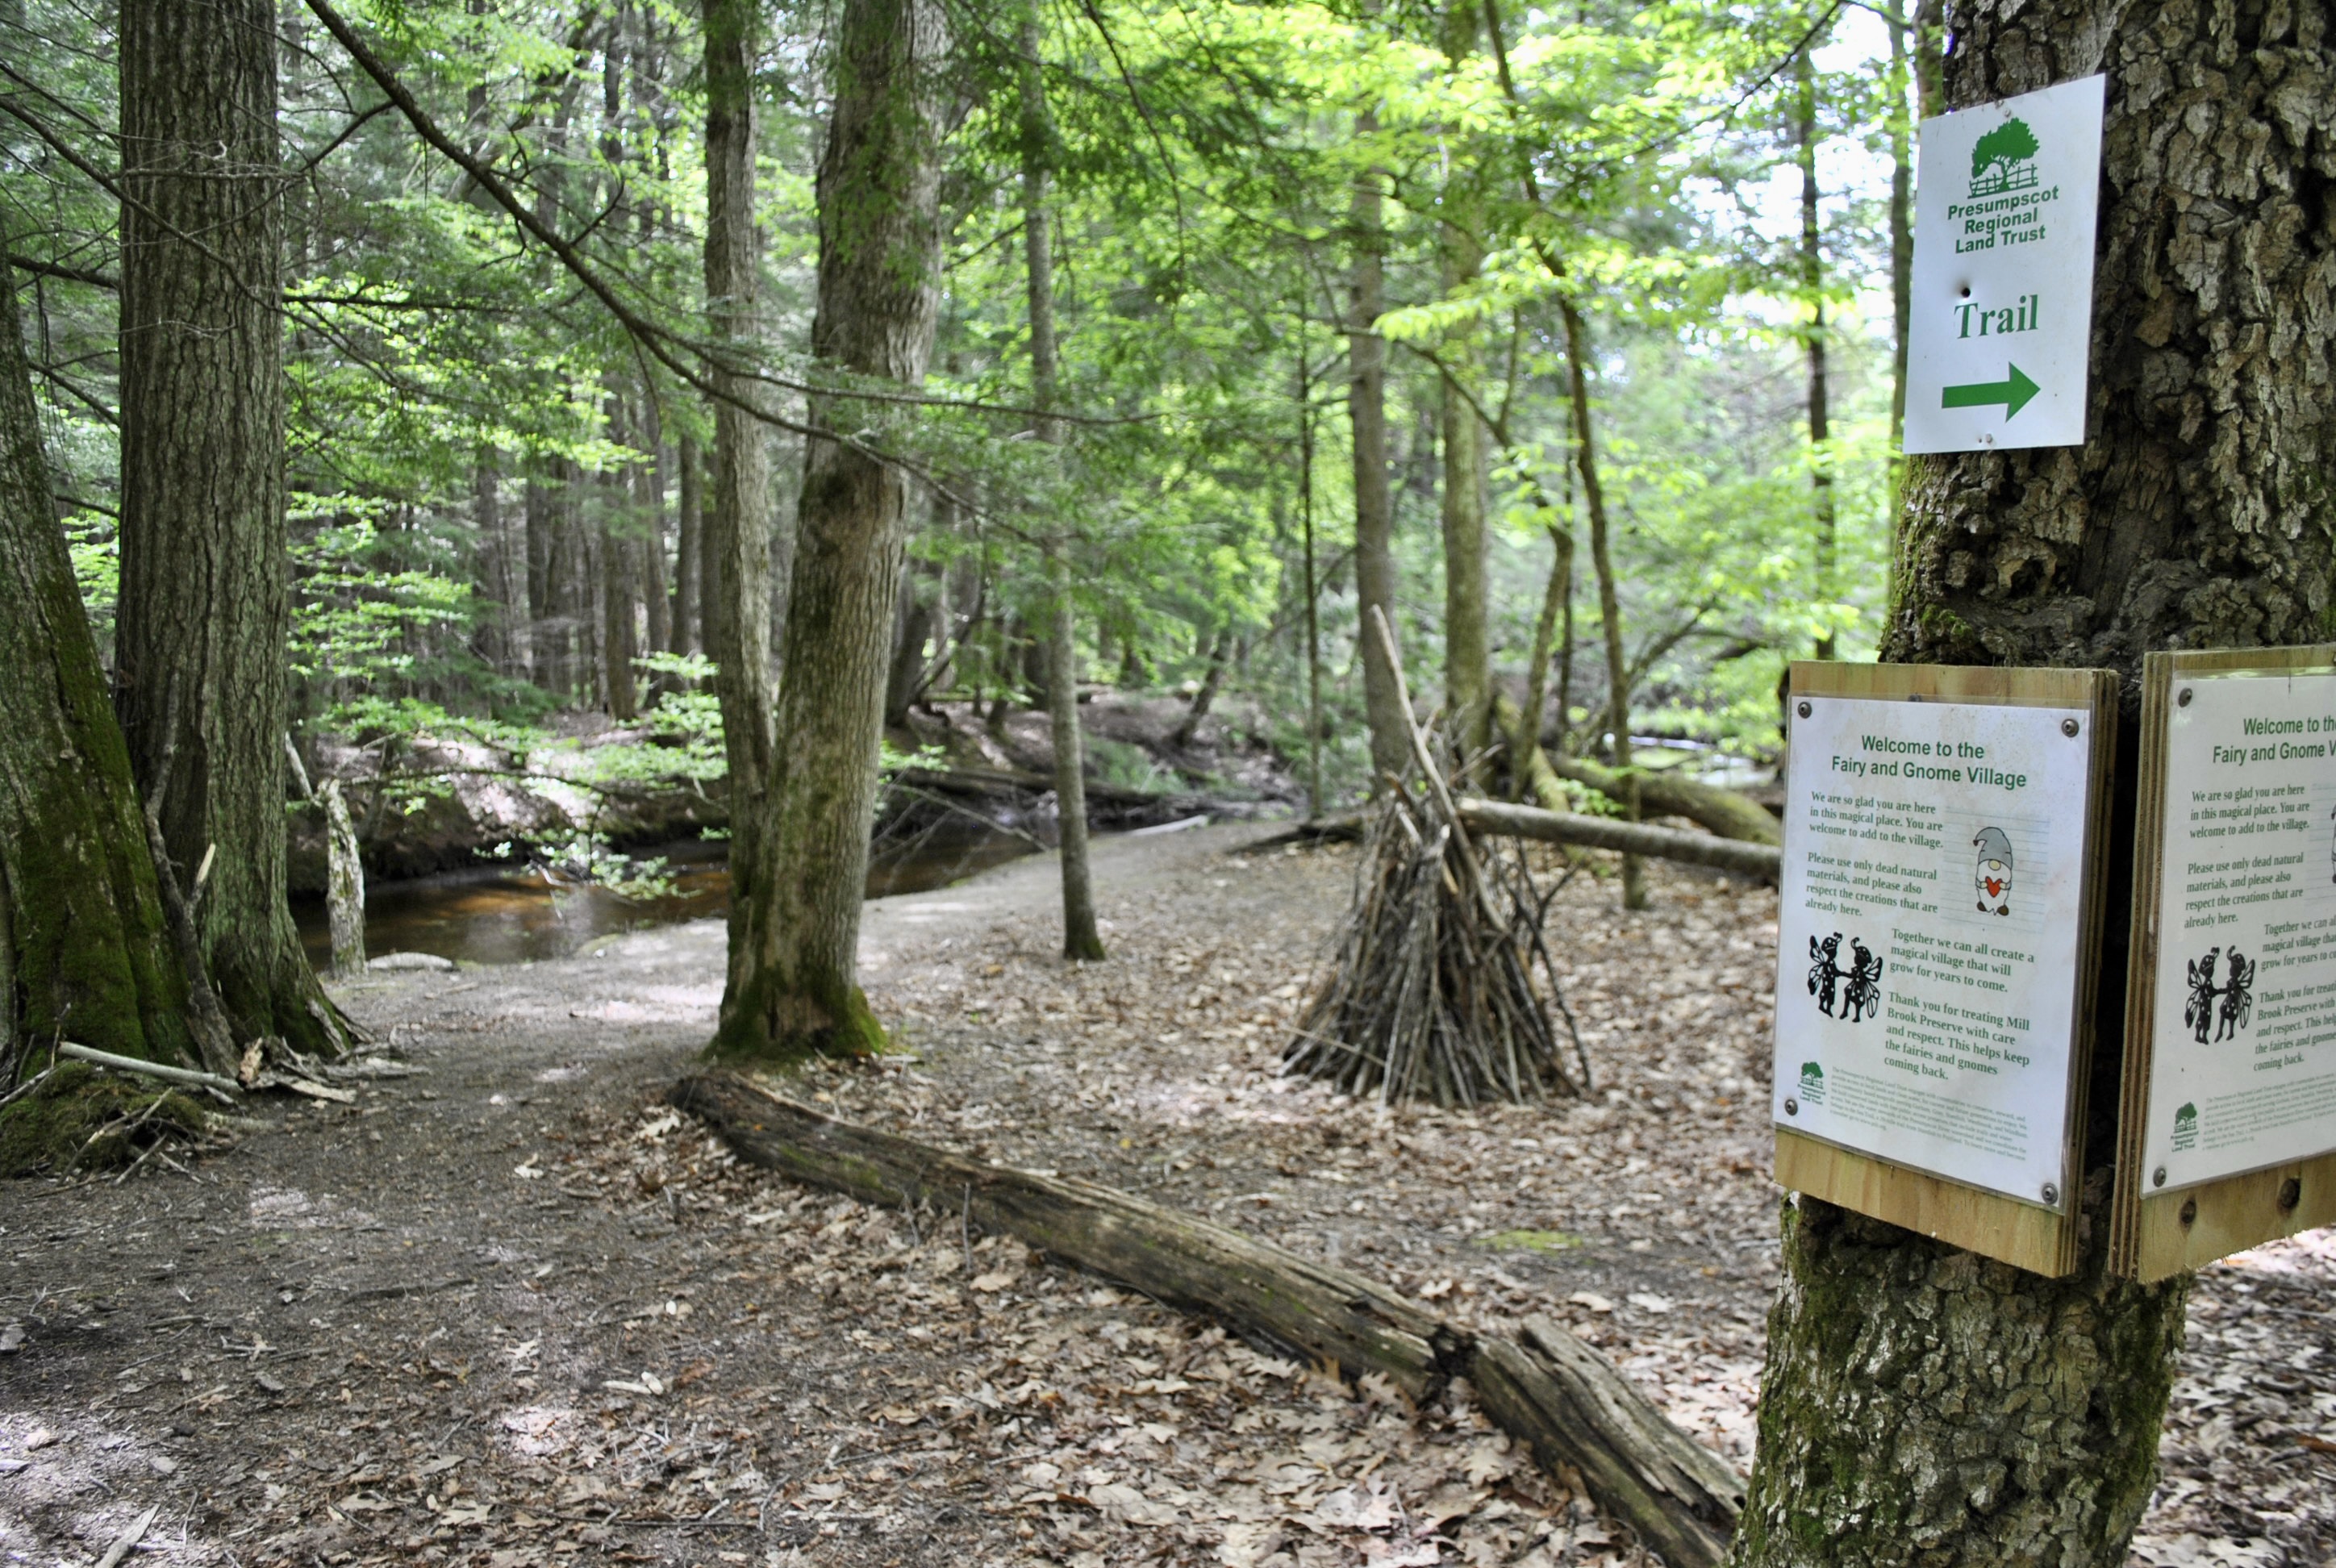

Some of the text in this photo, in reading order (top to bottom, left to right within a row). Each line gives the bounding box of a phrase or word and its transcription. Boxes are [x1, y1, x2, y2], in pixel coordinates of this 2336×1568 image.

[1948, 185, 2059, 219] Presumpscot
[1965, 206, 2038, 234] Regional
[1955, 224, 2046, 253] Land Trust
[1954, 294, 2039, 339] Trail
[2243, 715, 2336, 736] Welcome to th
[1862, 736, 1985, 758] Welcome to the
[2213, 745, 2246, 766] Fairy
[2251, 743, 2276, 761] and
[2280, 742, 2325, 759] Gnome
[1832, 756, 2026, 790] Fairy and Gnome Village
[1812, 791, 1935, 814] We are so glad you are here
[2192, 790, 2205, 802] We
[2208, 792, 2221, 801] are
[2234, 787, 2253, 803] glad
[2255, 789, 2270, 800] you
[2272, 787, 2285, 796] are
[2288, 784, 2305, 794] here
[1810, 807, 1942, 832] in this magical place. You are
[2191, 802, 2309, 820] in this magical place. You are
[1809, 823, 1943, 849] welcome to add to the village.
[2190, 819, 2309, 838] welcome to add to the village.
[1808, 853, 1835, 865] Please
[1854, 861, 1872, 873] only
[1875, 862, 1898, 874] dead
[1901, 867, 1937, 880] natural
[2188, 852, 2304, 874] Please use only dead natural
[1807, 869, 1921, 894] materials, and please also
[2187, 871, 2291, 892] materials, and please also
[1805, 899, 1863, 916] already here.
[1806, 885, 1938, 913] respect the creations that are
[2186, 888, 2303, 911] respect the creations that are
[2184, 912, 2238, 928] already here.
[2264, 921, 2299, 936] Together
[2301, 921, 2312, 929] we
[2314, 920, 2327, 928] can
[1892, 928, 2034, 963] Together we can all create a
[2263, 932, 2336, 953] magical village tha
[1891, 946, 2011, 976] magical village that will
[2261, 959, 2280, 972] grow
[2284, 955, 2295, 966] for
[2296, 953, 2317, 967] years
[2320, 952, 2327, 961] to
[1890, 962, 2008, 993] grow for years to come.
[2259, 989, 2284, 1003] Thank
[2287, 988, 2301, 1002] you
[2304, 986, 2314, 996] for
[1888, 991, 2029, 1030] Thank you for treating Mill
[2258, 997, 2335, 1020] Brook Preserve with
[1888, 1007, 2015, 1045] Brook Preserve with care
[2256, 1025, 2271, 1037] and
[2273, 1022, 2302, 1036] respect.
[2305, 1016, 2321, 1028] This
[1887, 1024, 2029, 1067] and respect. This helps keep
[2255, 1044, 2267, 1054] the
[2270, 1037, 2293, 1052] fairies
[2296, 1035, 2310, 1046] and
[1884, 1056, 1949, 1080] coming back.
[1885, 1040, 1998, 1075] the fairies and gnomes
[2254, 1053, 2305, 1071] coming back.
